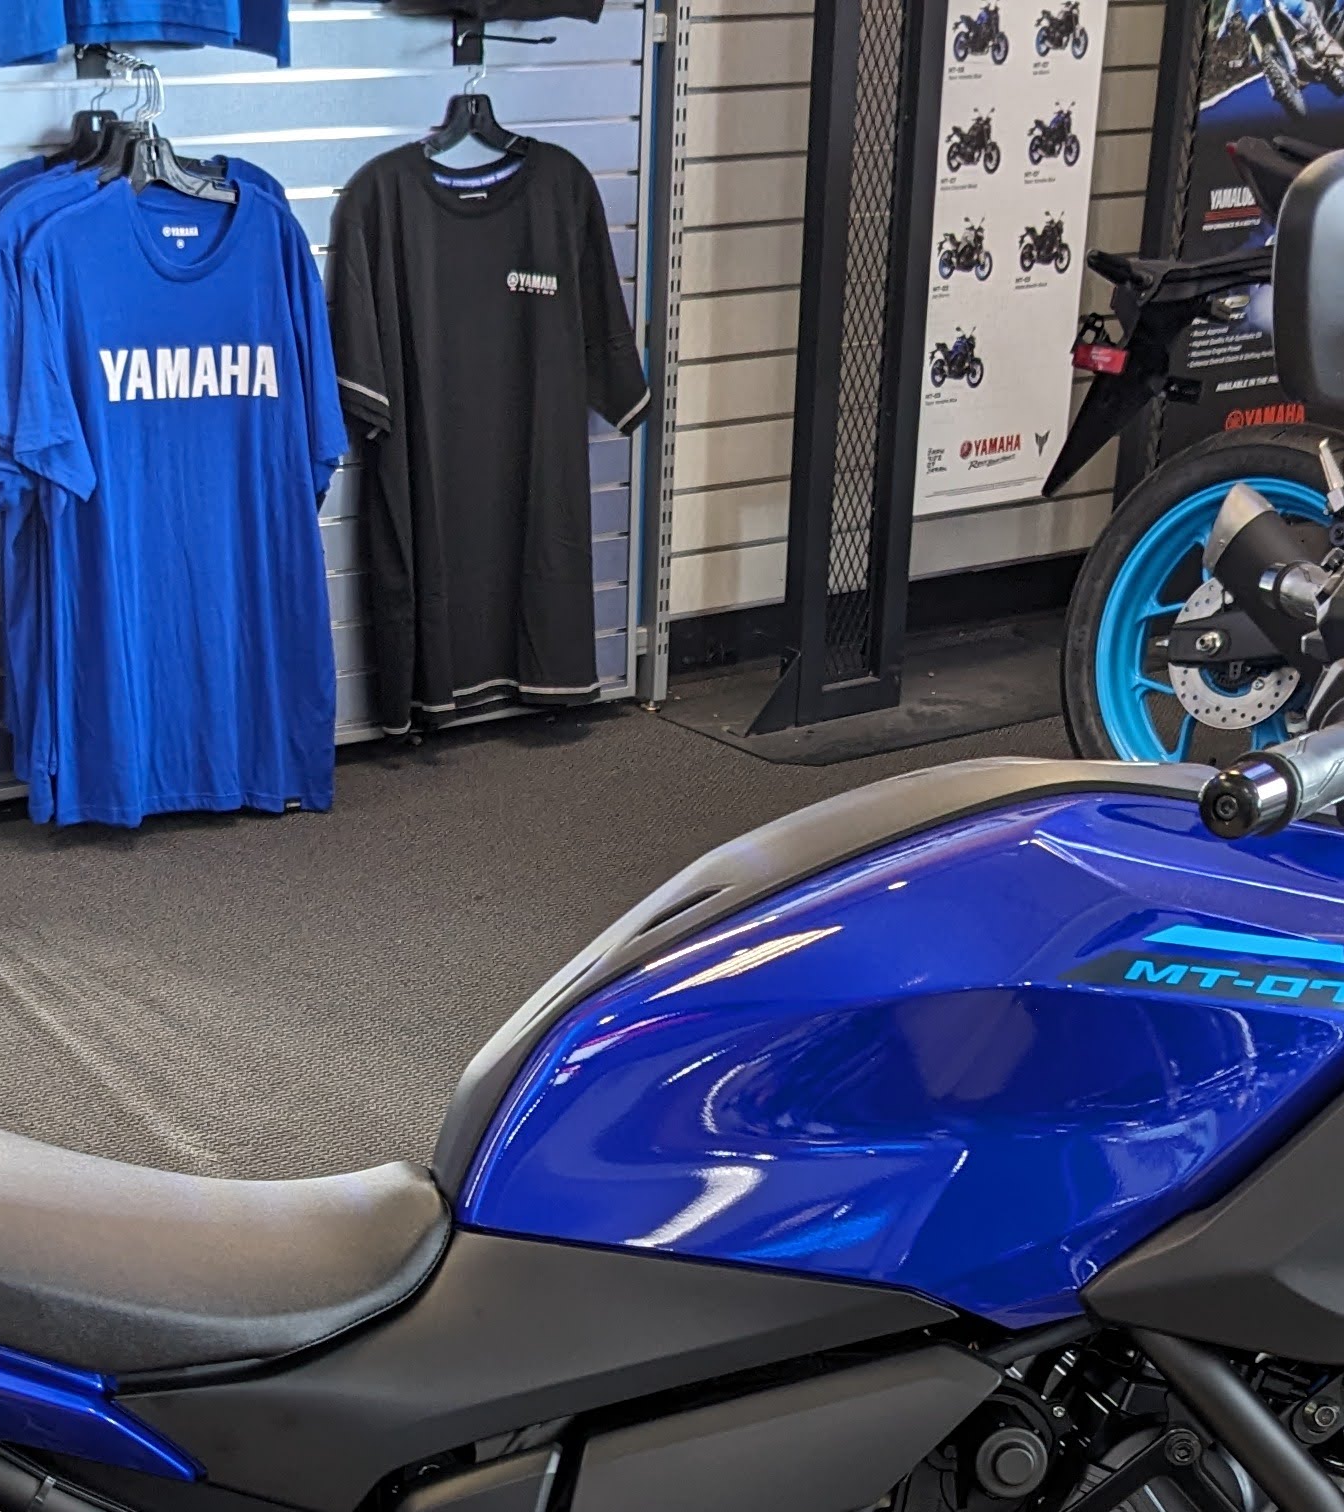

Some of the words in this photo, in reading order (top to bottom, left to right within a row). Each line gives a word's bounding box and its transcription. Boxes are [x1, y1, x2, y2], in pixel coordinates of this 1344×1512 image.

[519, 272, 558, 290] YAMAHA
[98, 344, 279, 403] YAMAHA
[1245, 403, 1305, 426] YAMAHA
[974, 433, 1021, 457] YAMAHA
